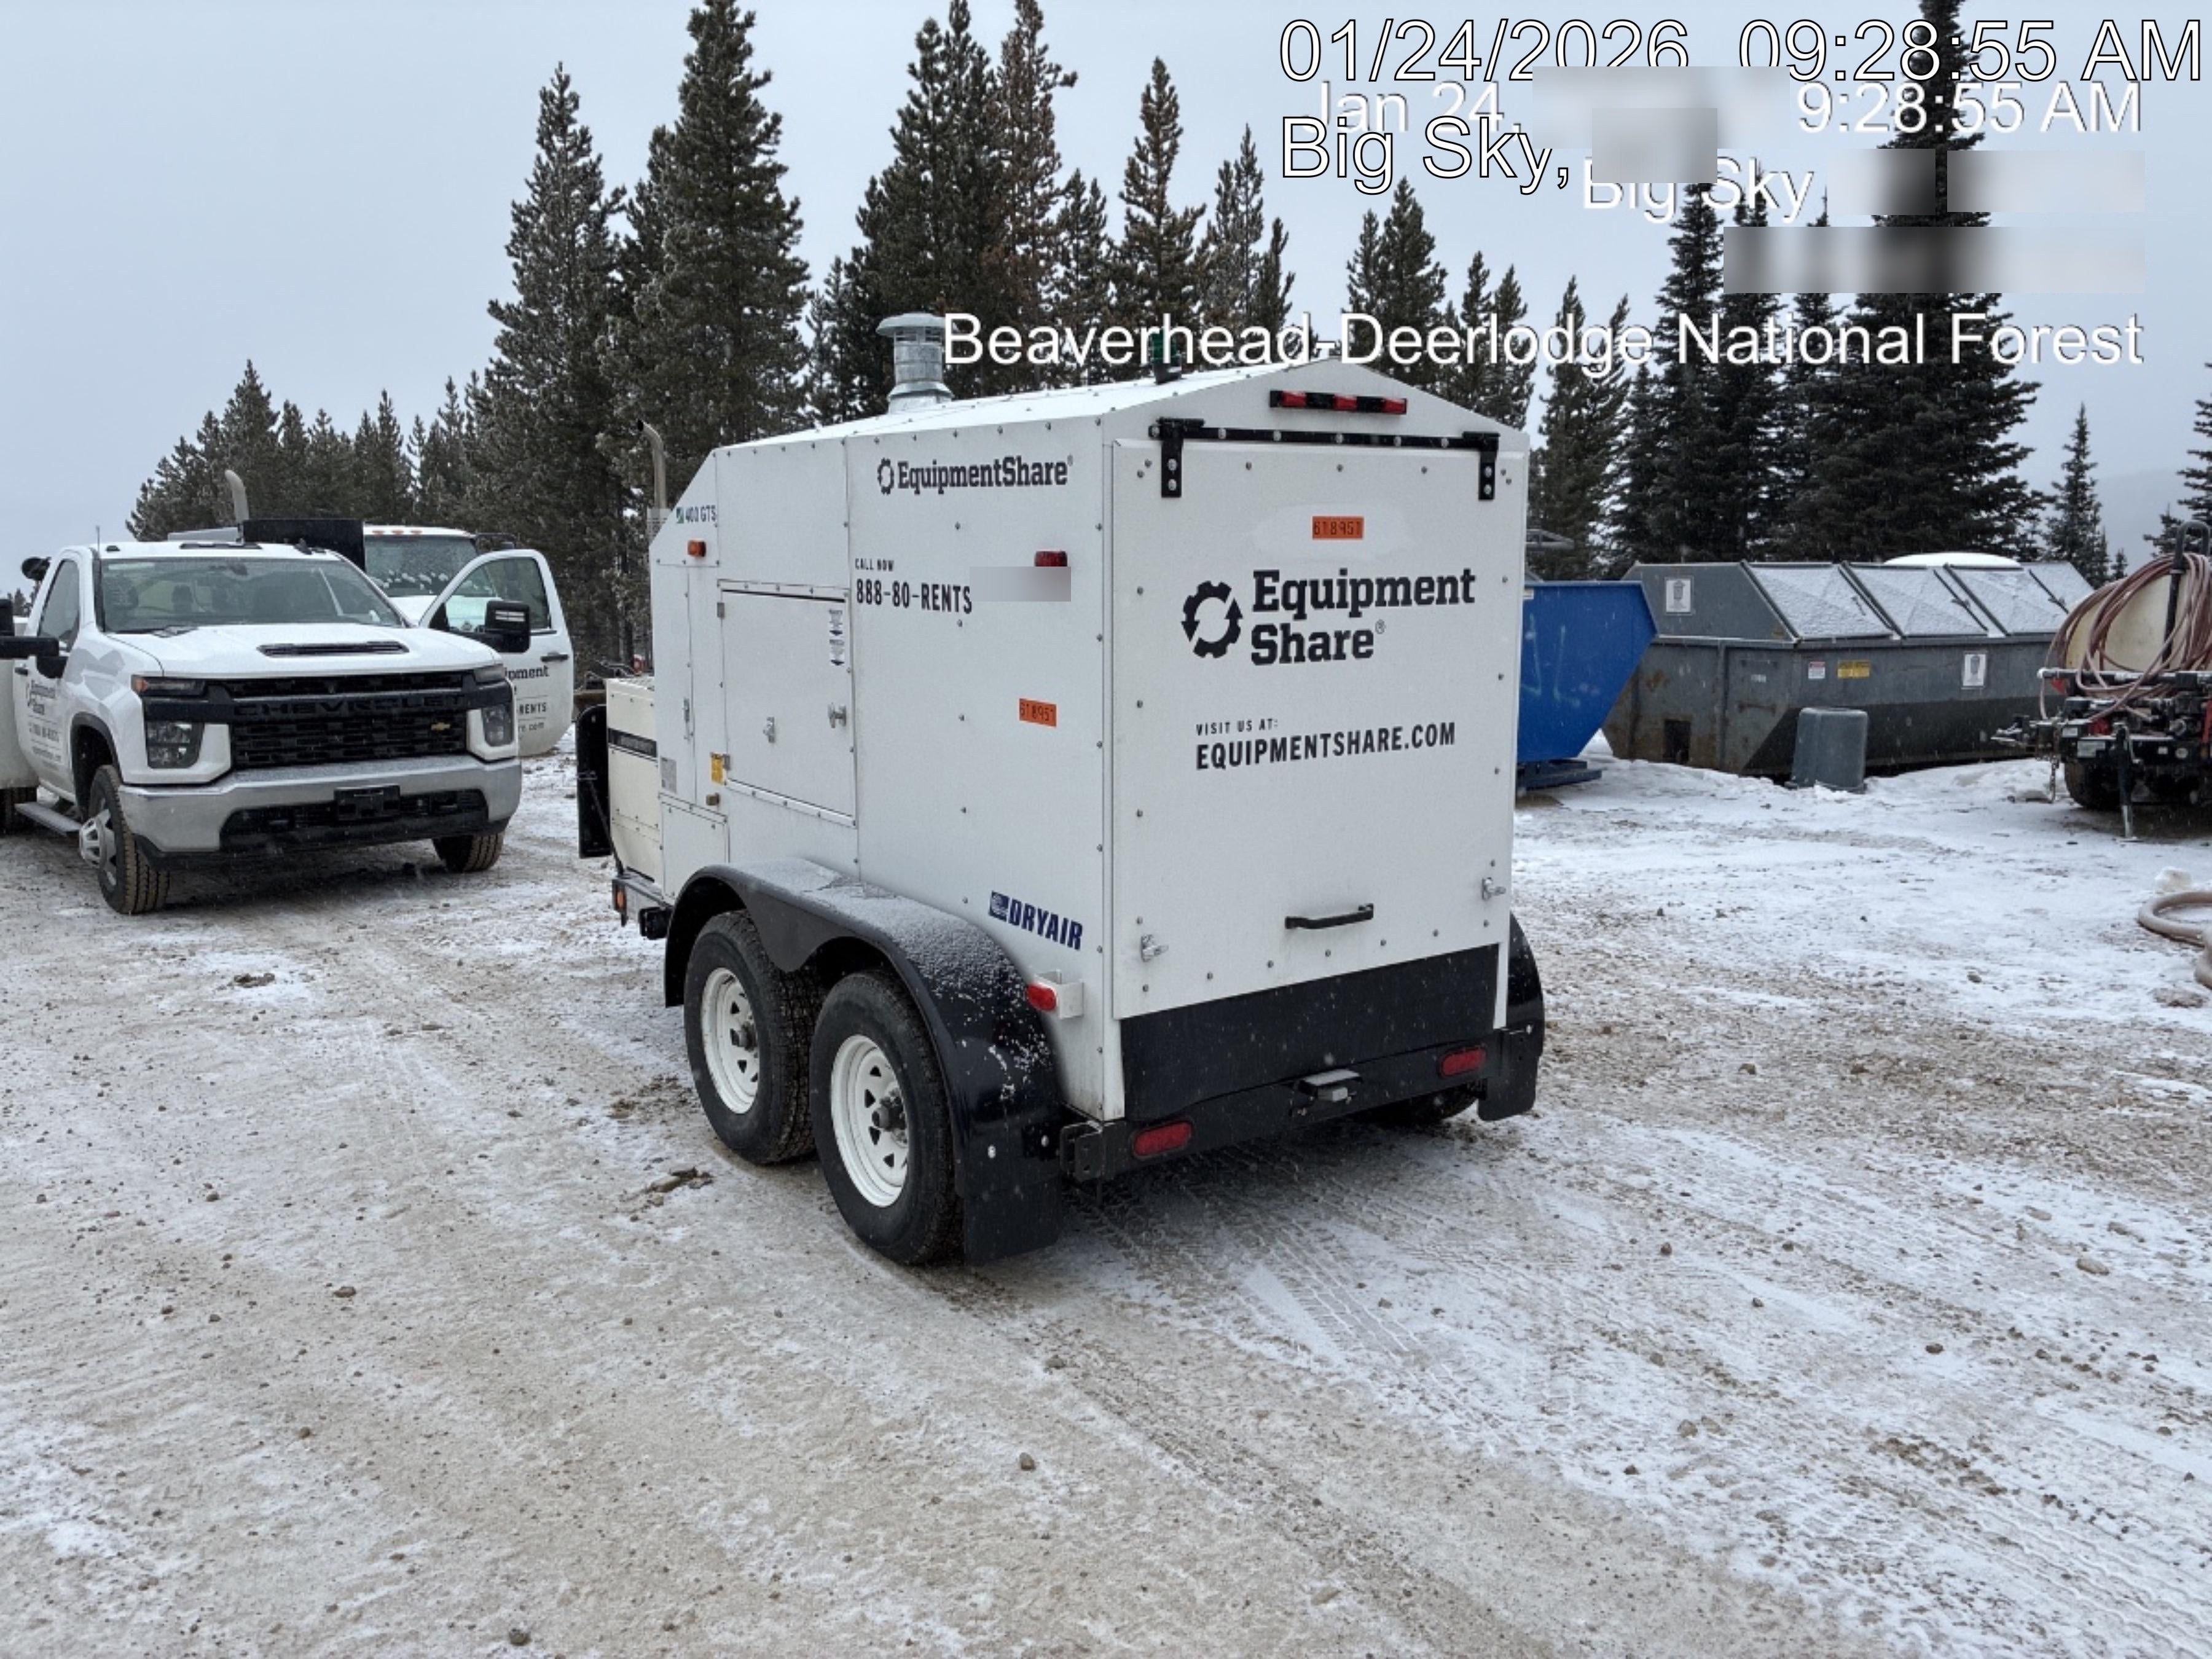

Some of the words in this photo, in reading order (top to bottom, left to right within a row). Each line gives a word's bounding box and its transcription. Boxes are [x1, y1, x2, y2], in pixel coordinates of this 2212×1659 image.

[855, 557, 874, 571] CALL
[856, 579, 973, 614] 888-80-RENTS
[1252, 568, 1476, 621] Equipment
[1196, 720, 1230, 736] VISIT
[1236, 720, 1252, 732] US
[1196, 721, 1456, 770] EQUIPMENTSHARE.COM
[1008, 898, 1083, 952] DRYAIR
